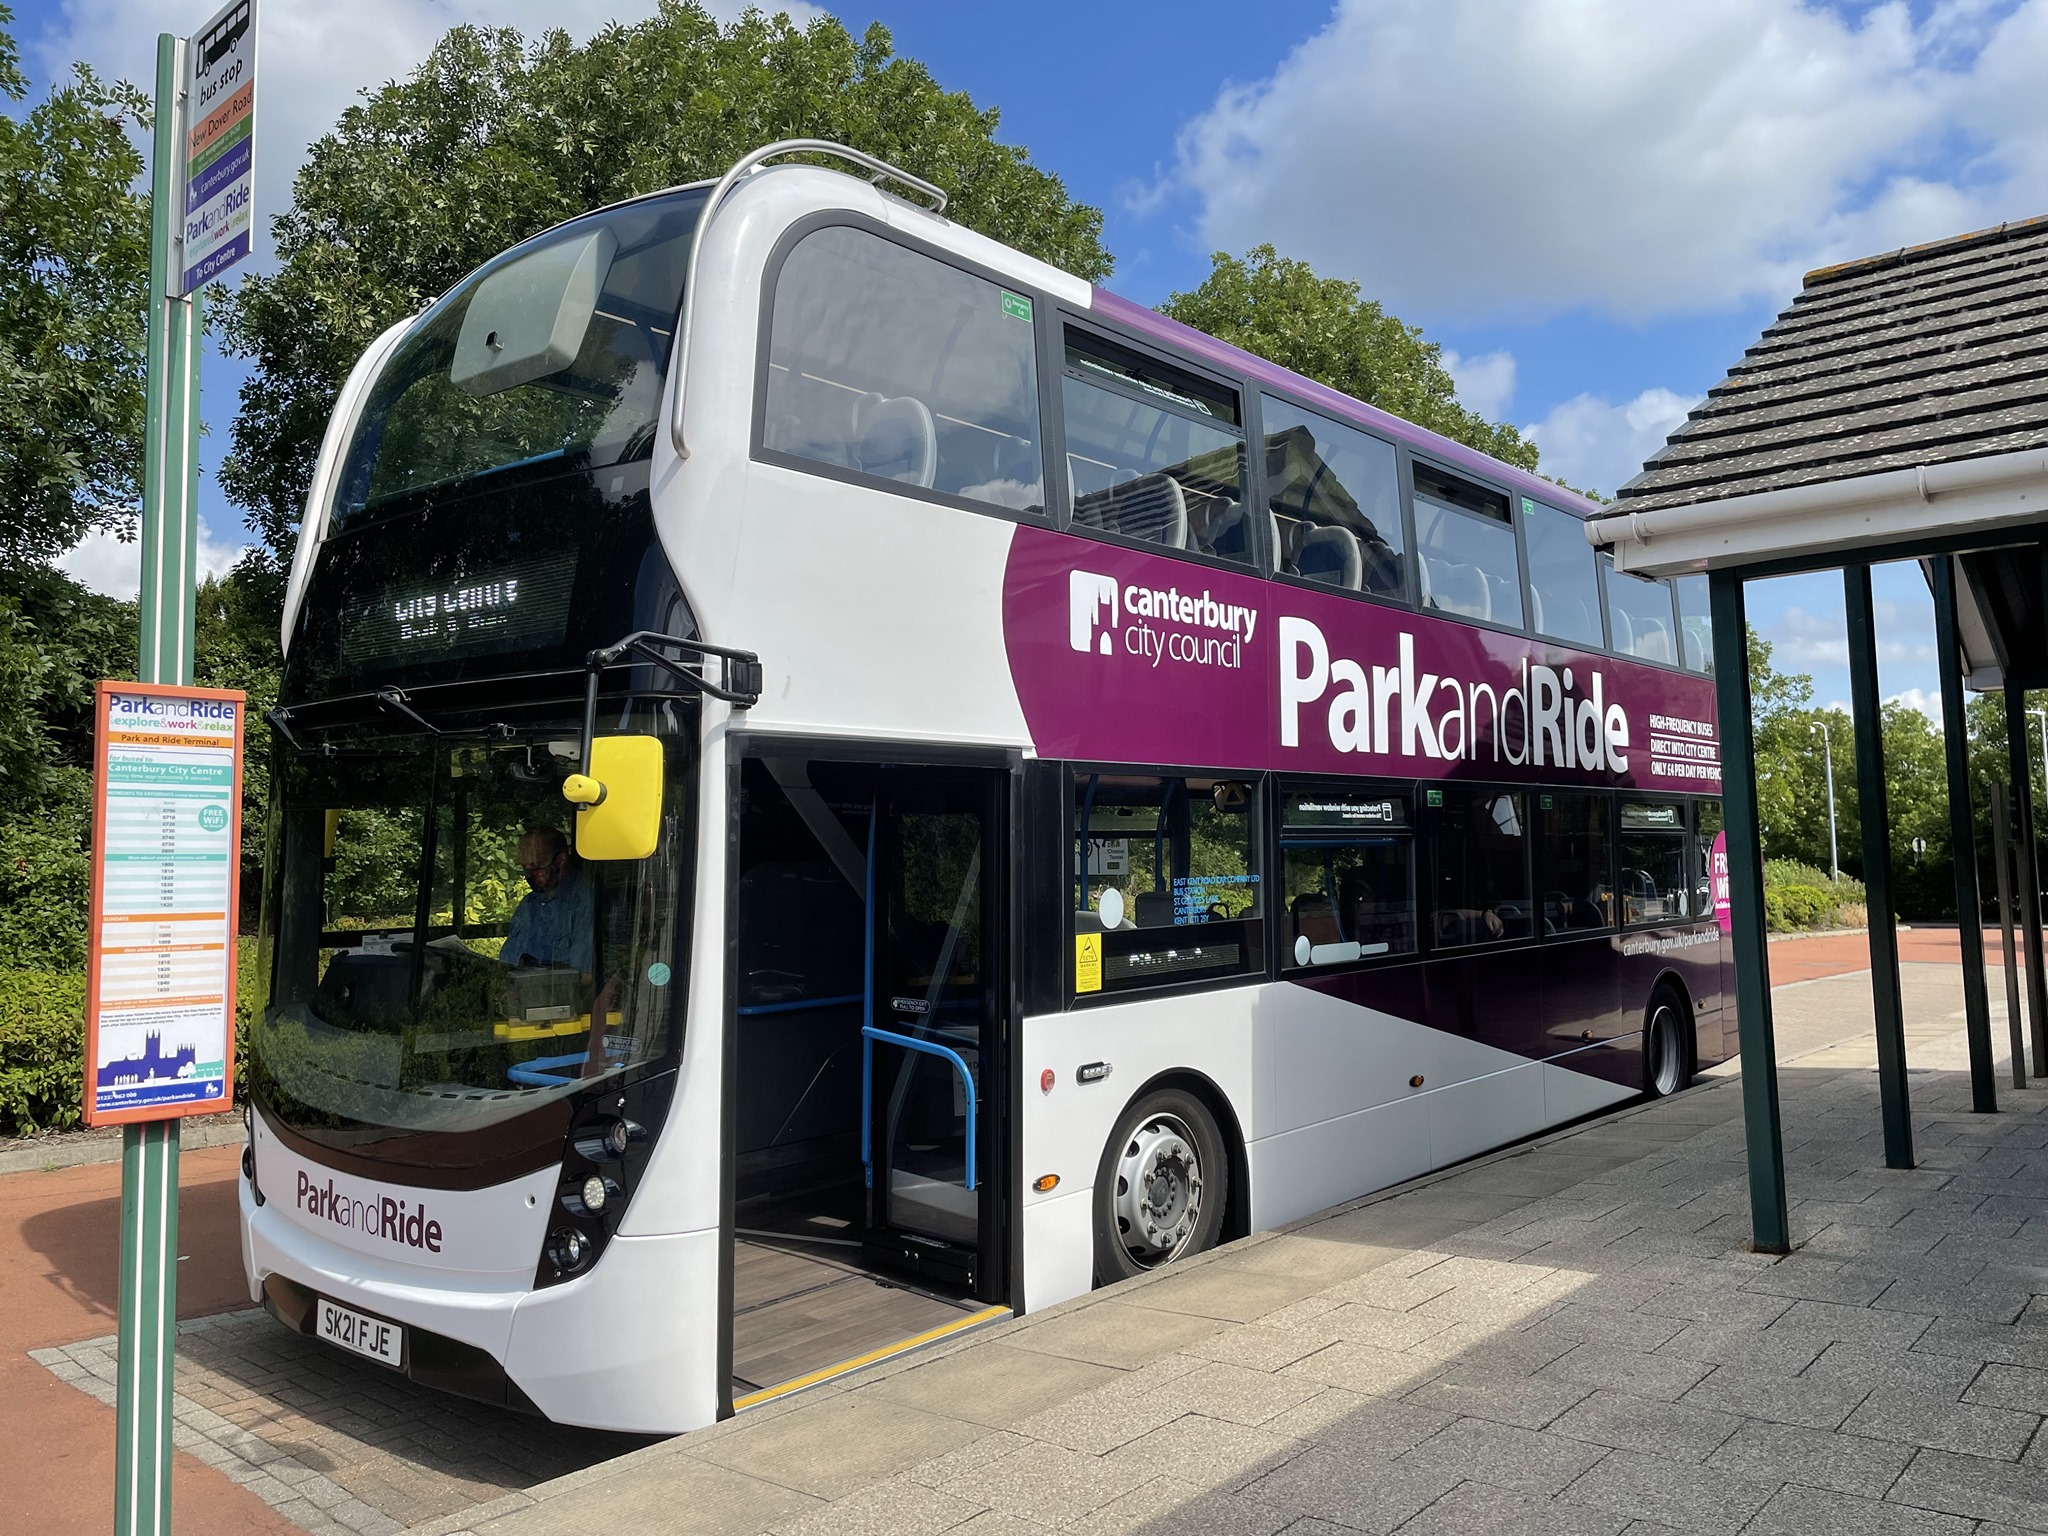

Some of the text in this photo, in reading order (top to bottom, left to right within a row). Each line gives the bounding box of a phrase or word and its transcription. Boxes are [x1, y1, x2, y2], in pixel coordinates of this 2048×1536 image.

[200, 58, 243, 107] bus stop
[191, 128, 207, 147] New
[208, 109, 231, 136] Dover
[232, 87, 252, 116] Road
[200, 147, 250, 194] canterbury.gov.uk
[196, 247, 236, 280] To City Centre
[1124, 585, 1257, 644] canterbury
[1125, 618, 1241, 669] city council
[1279, 615, 1629, 774] ParkandRide
[1649, 714, 1713, 737] HIGH-FREQUENCY BUSES
[121, 734, 219, 746] Park and Ride Terminal
[1650, 739, 1716, 759] DIRECT INTO CITY CENTRE
[108, 763, 223, 776] Canterbury City Centre
[1651, 761, 1667, 775] ONLY
[1667, 763, 1675, 776] £4
[1675, 764, 1686, 777] PER
[1686, 765, 1697, 778] DAY
[1697, 766, 1707, 779] PER
[203, 816, 223, 824] WiFi
[1173, 877, 1186, 886] EAST
[1187, 877, 1200, 885] KENT
[1251, 874, 1260, 882] LTD
[1173, 887, 1206, 896] BUS STATION
[1173, 905, 1206, 915] CANTERBURY
[1206, 894, 1219, 903] LANE
[1174, 916, 1187, 925] KENT
[1623, 926, 1719, 956] canterbury.gov.uk/parkandride
[297, 1170, 442, 1253] ParkandRide
[325, 1307, 391, 1357] SK21 FJE
